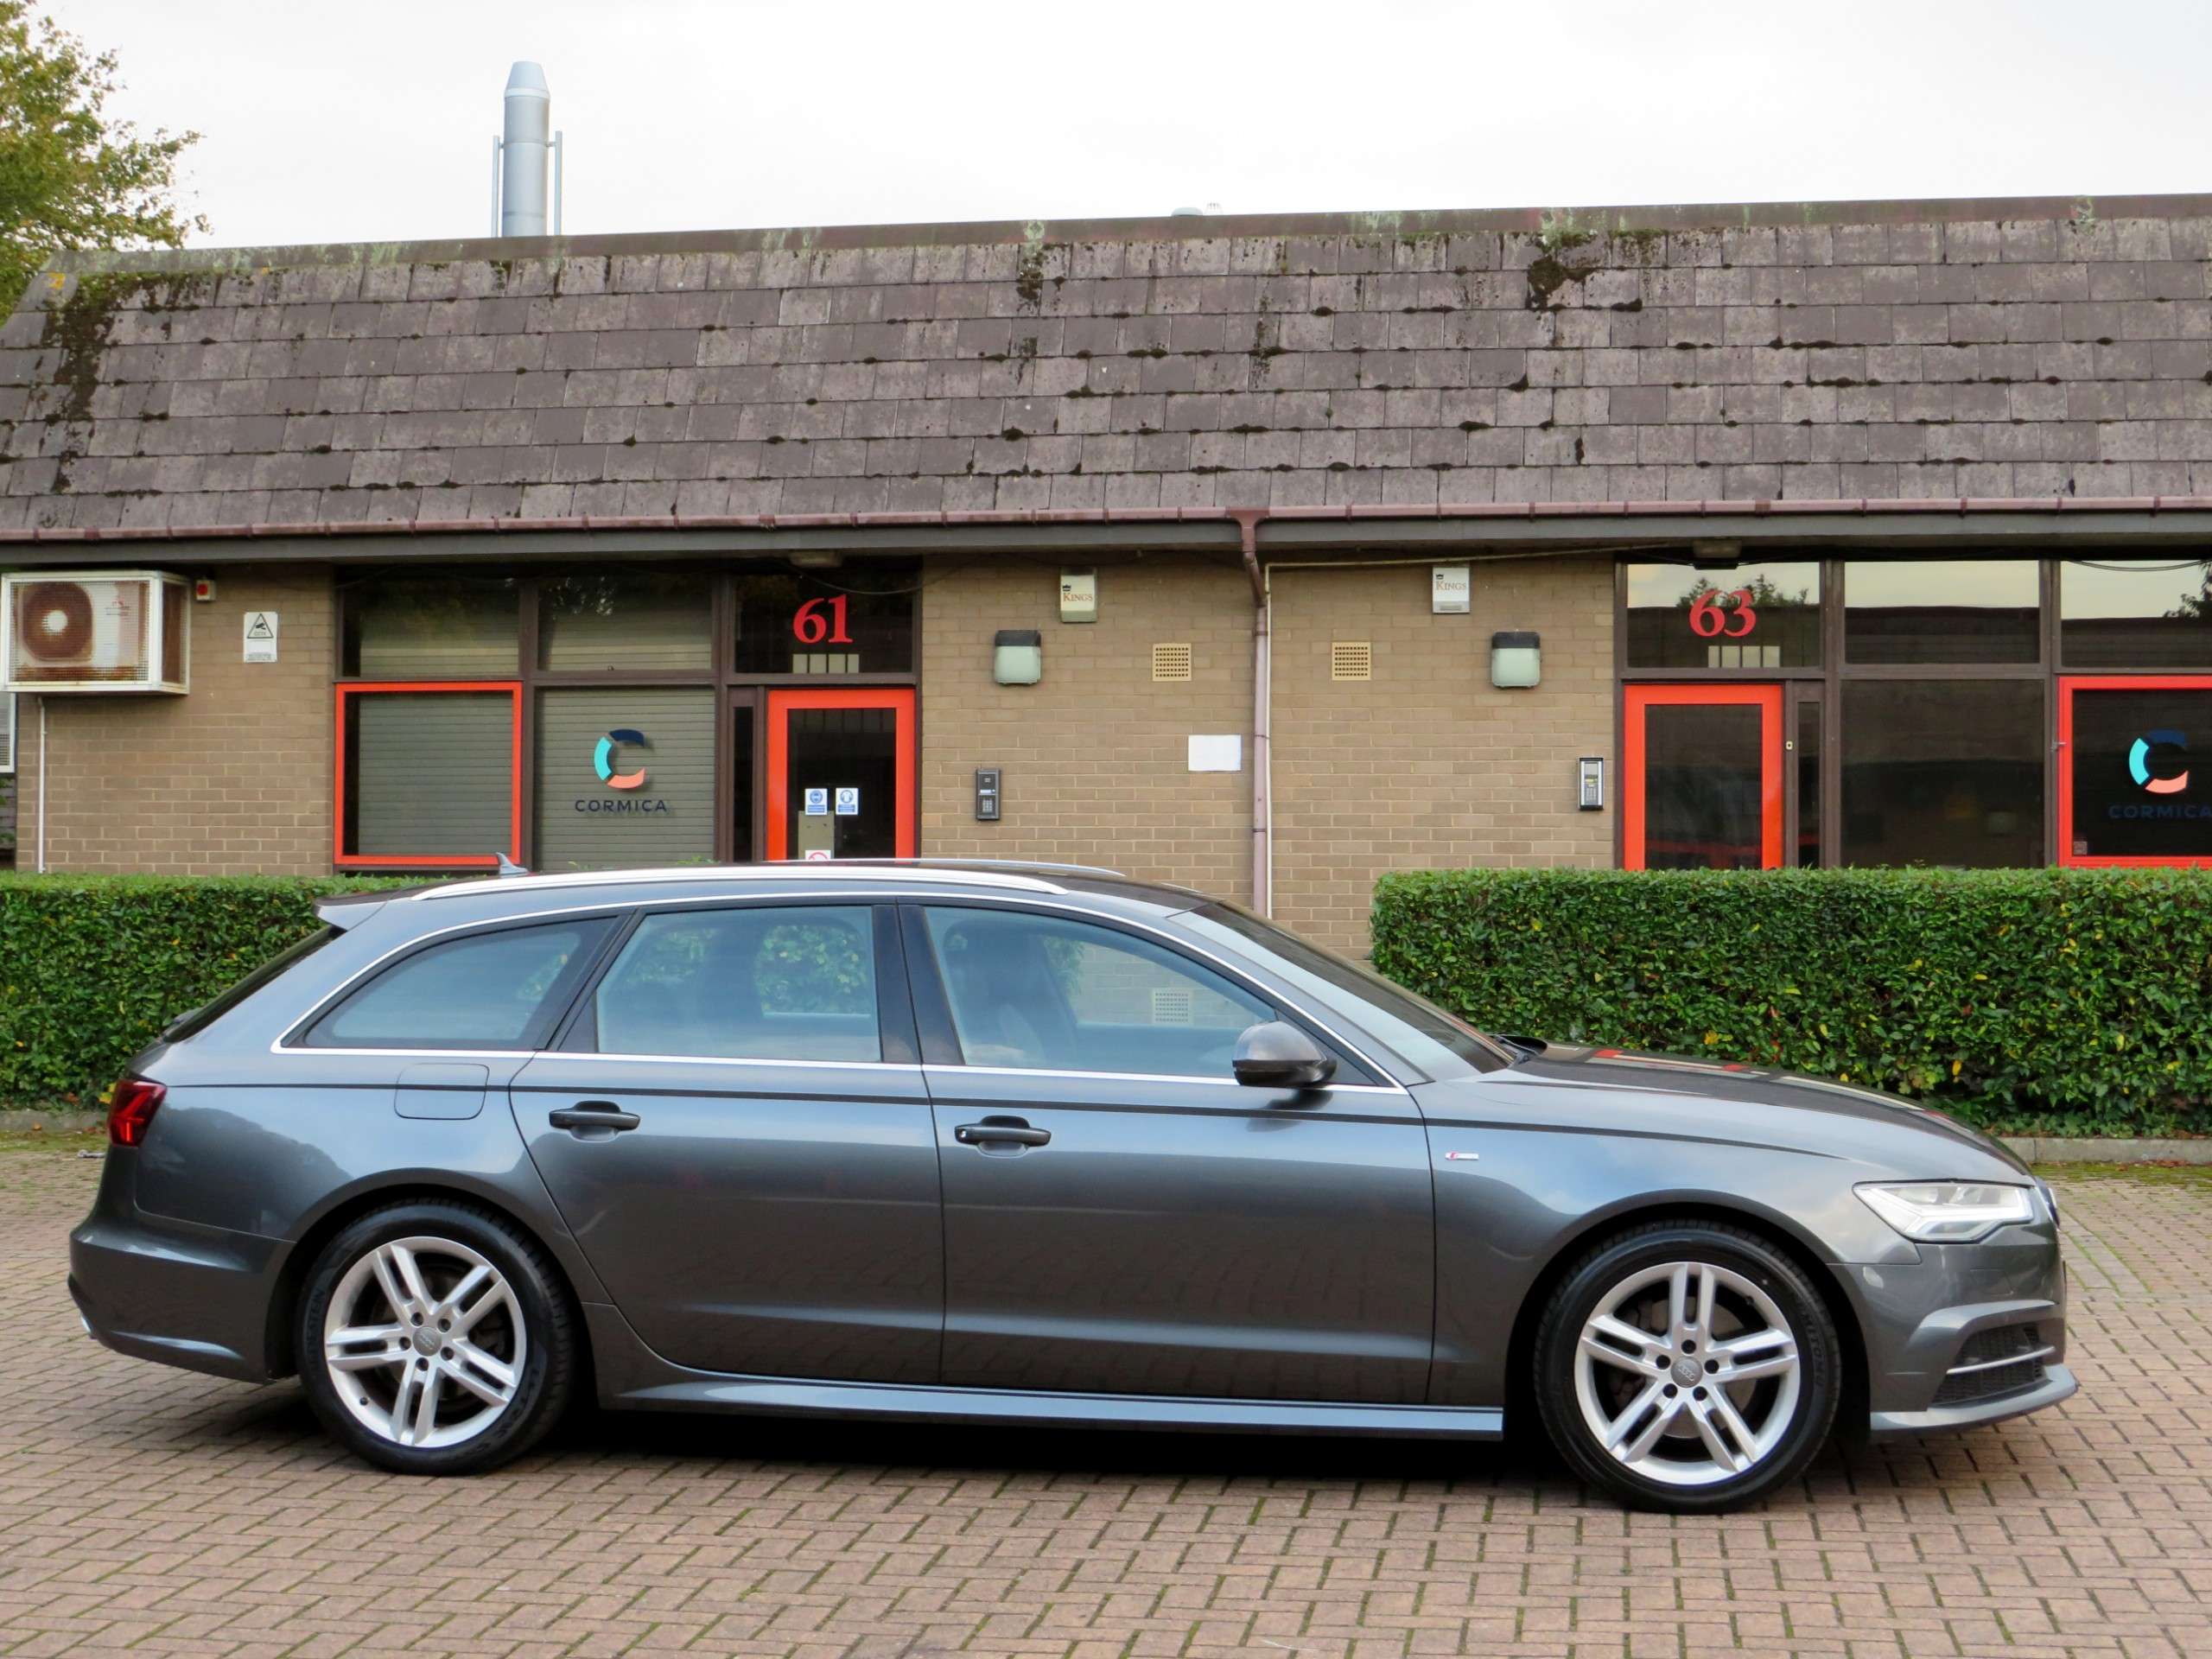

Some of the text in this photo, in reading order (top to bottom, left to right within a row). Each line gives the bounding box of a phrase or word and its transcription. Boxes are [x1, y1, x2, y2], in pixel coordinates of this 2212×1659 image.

[793, 594, 854, 644] 61
[1689, 588, 1756, 637] 63
[575, 799, 667, 812] CORMICA
[2108, 804, 2212, 819] CORMICA
